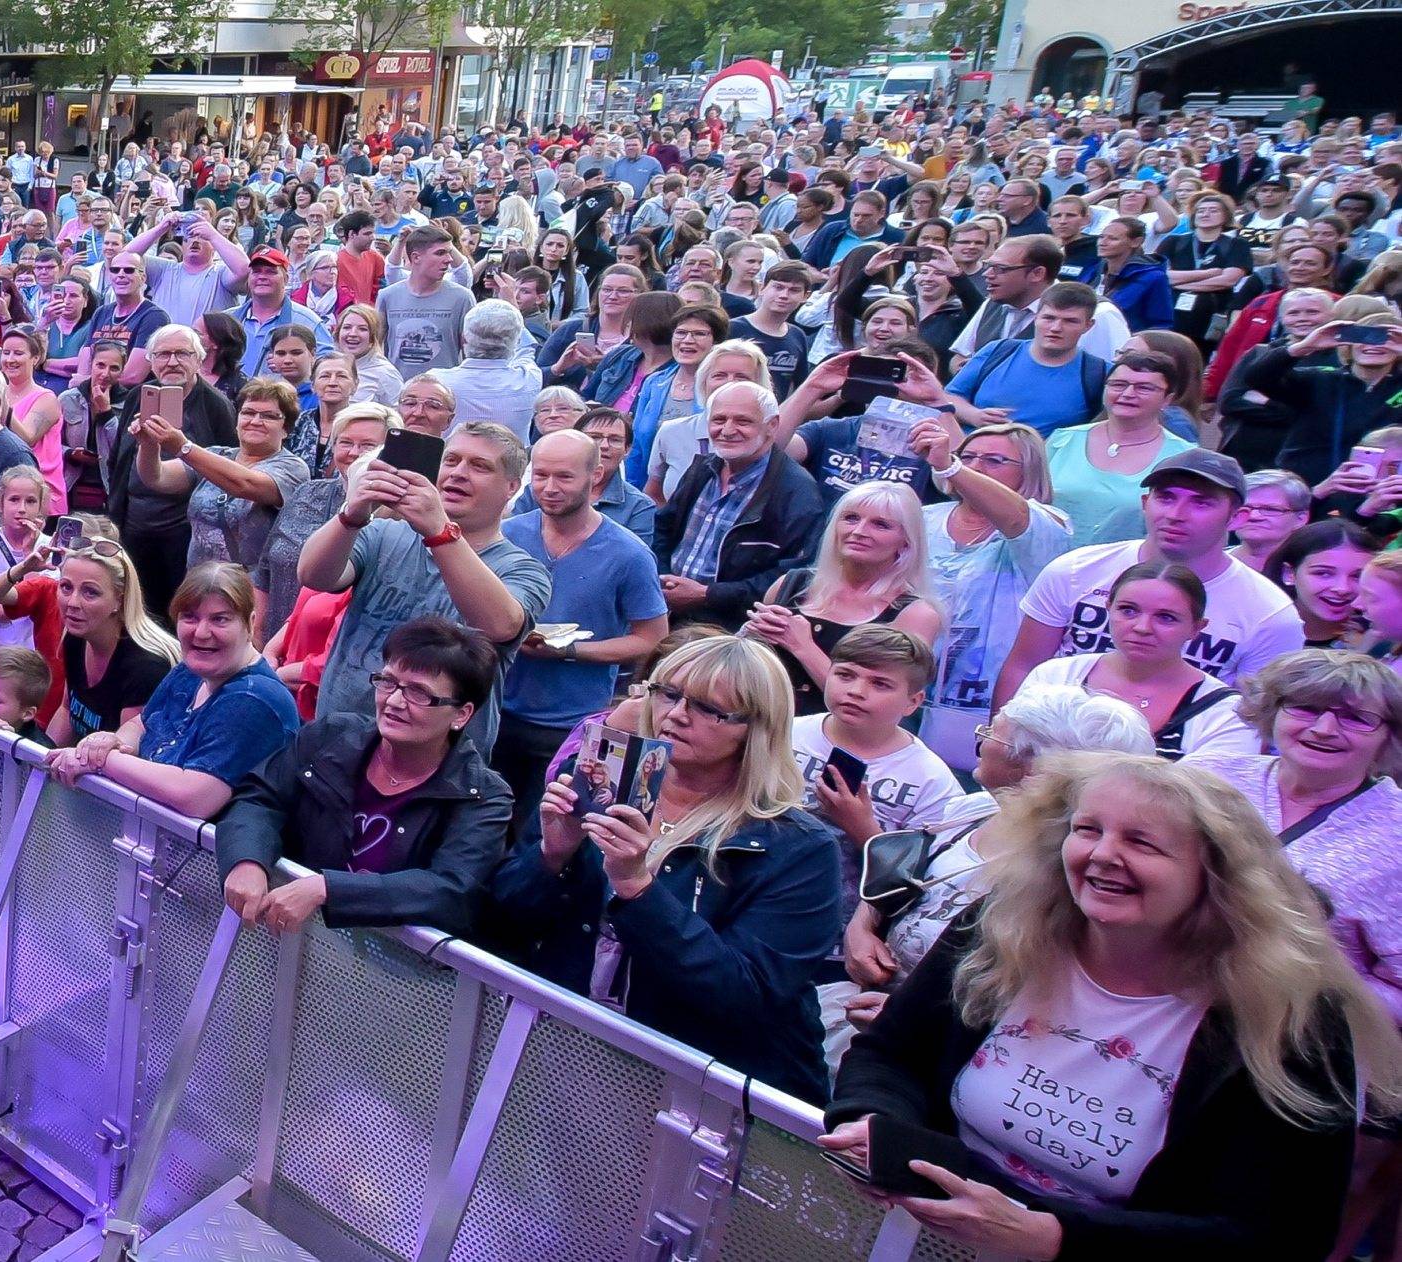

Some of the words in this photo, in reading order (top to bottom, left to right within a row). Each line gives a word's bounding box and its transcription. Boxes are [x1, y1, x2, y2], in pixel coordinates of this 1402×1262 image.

[330, 61, 353, 74] CR
[376, 57, 401, 73] SPIEL
[404, 57, 431, 73] ROYAL
[1017, 1063, 1104, 1114] Have
[1114, 1106, 1137, 1127] a
[1003, 1087, 1134, 1158] lovely
[1024, 1127, 1098, 1170] day
